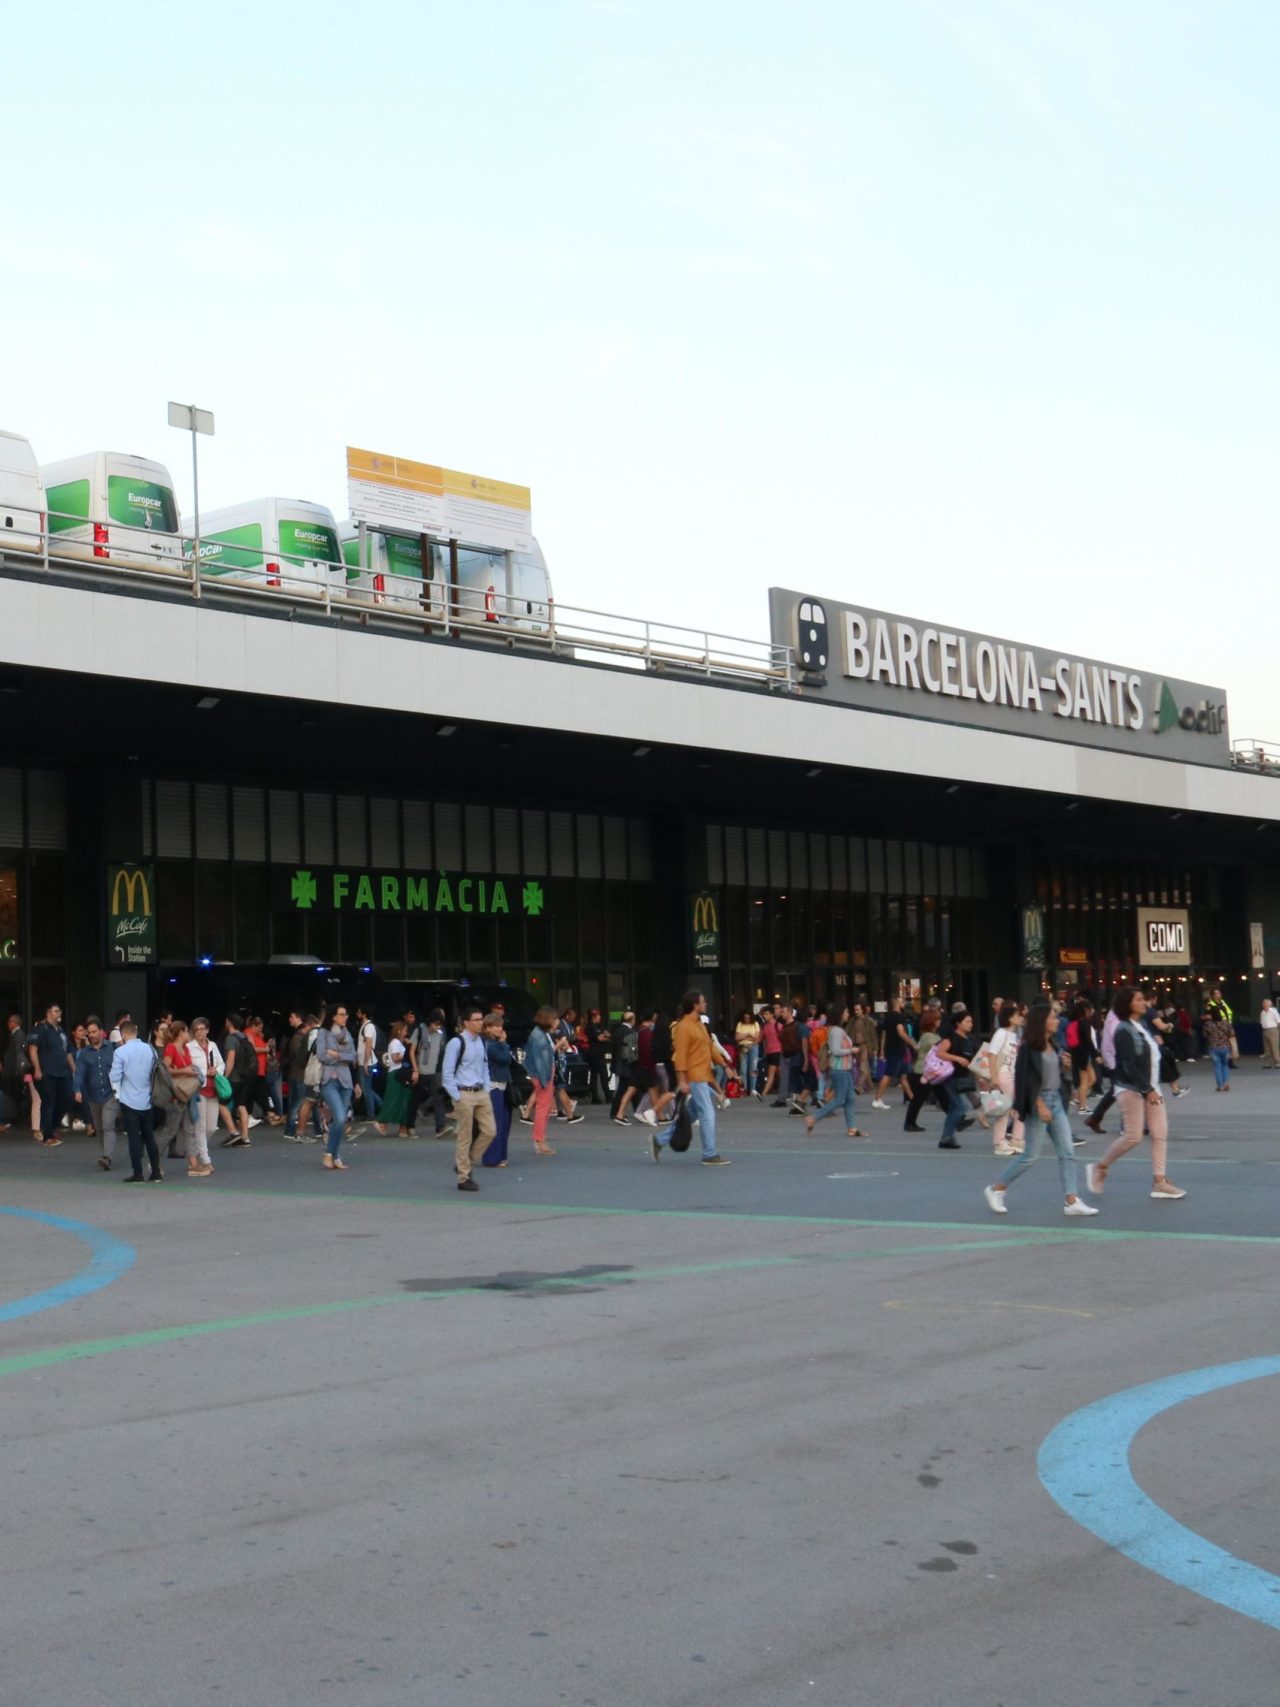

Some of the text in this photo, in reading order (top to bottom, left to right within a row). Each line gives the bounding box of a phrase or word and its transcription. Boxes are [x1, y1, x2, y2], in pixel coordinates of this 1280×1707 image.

[128, 492, 162, 508] Europcar
[294, 528, 328, 543] Europcar
[841, 611, 1144, 730] BARCELONA-SANTS
[333, 868, 510, 914] FARMÀCIA
[1149, 923, 1184, 952] COMO
[127, 945, 152, 954] Inside the
[127, 954, 146, 963] Station
